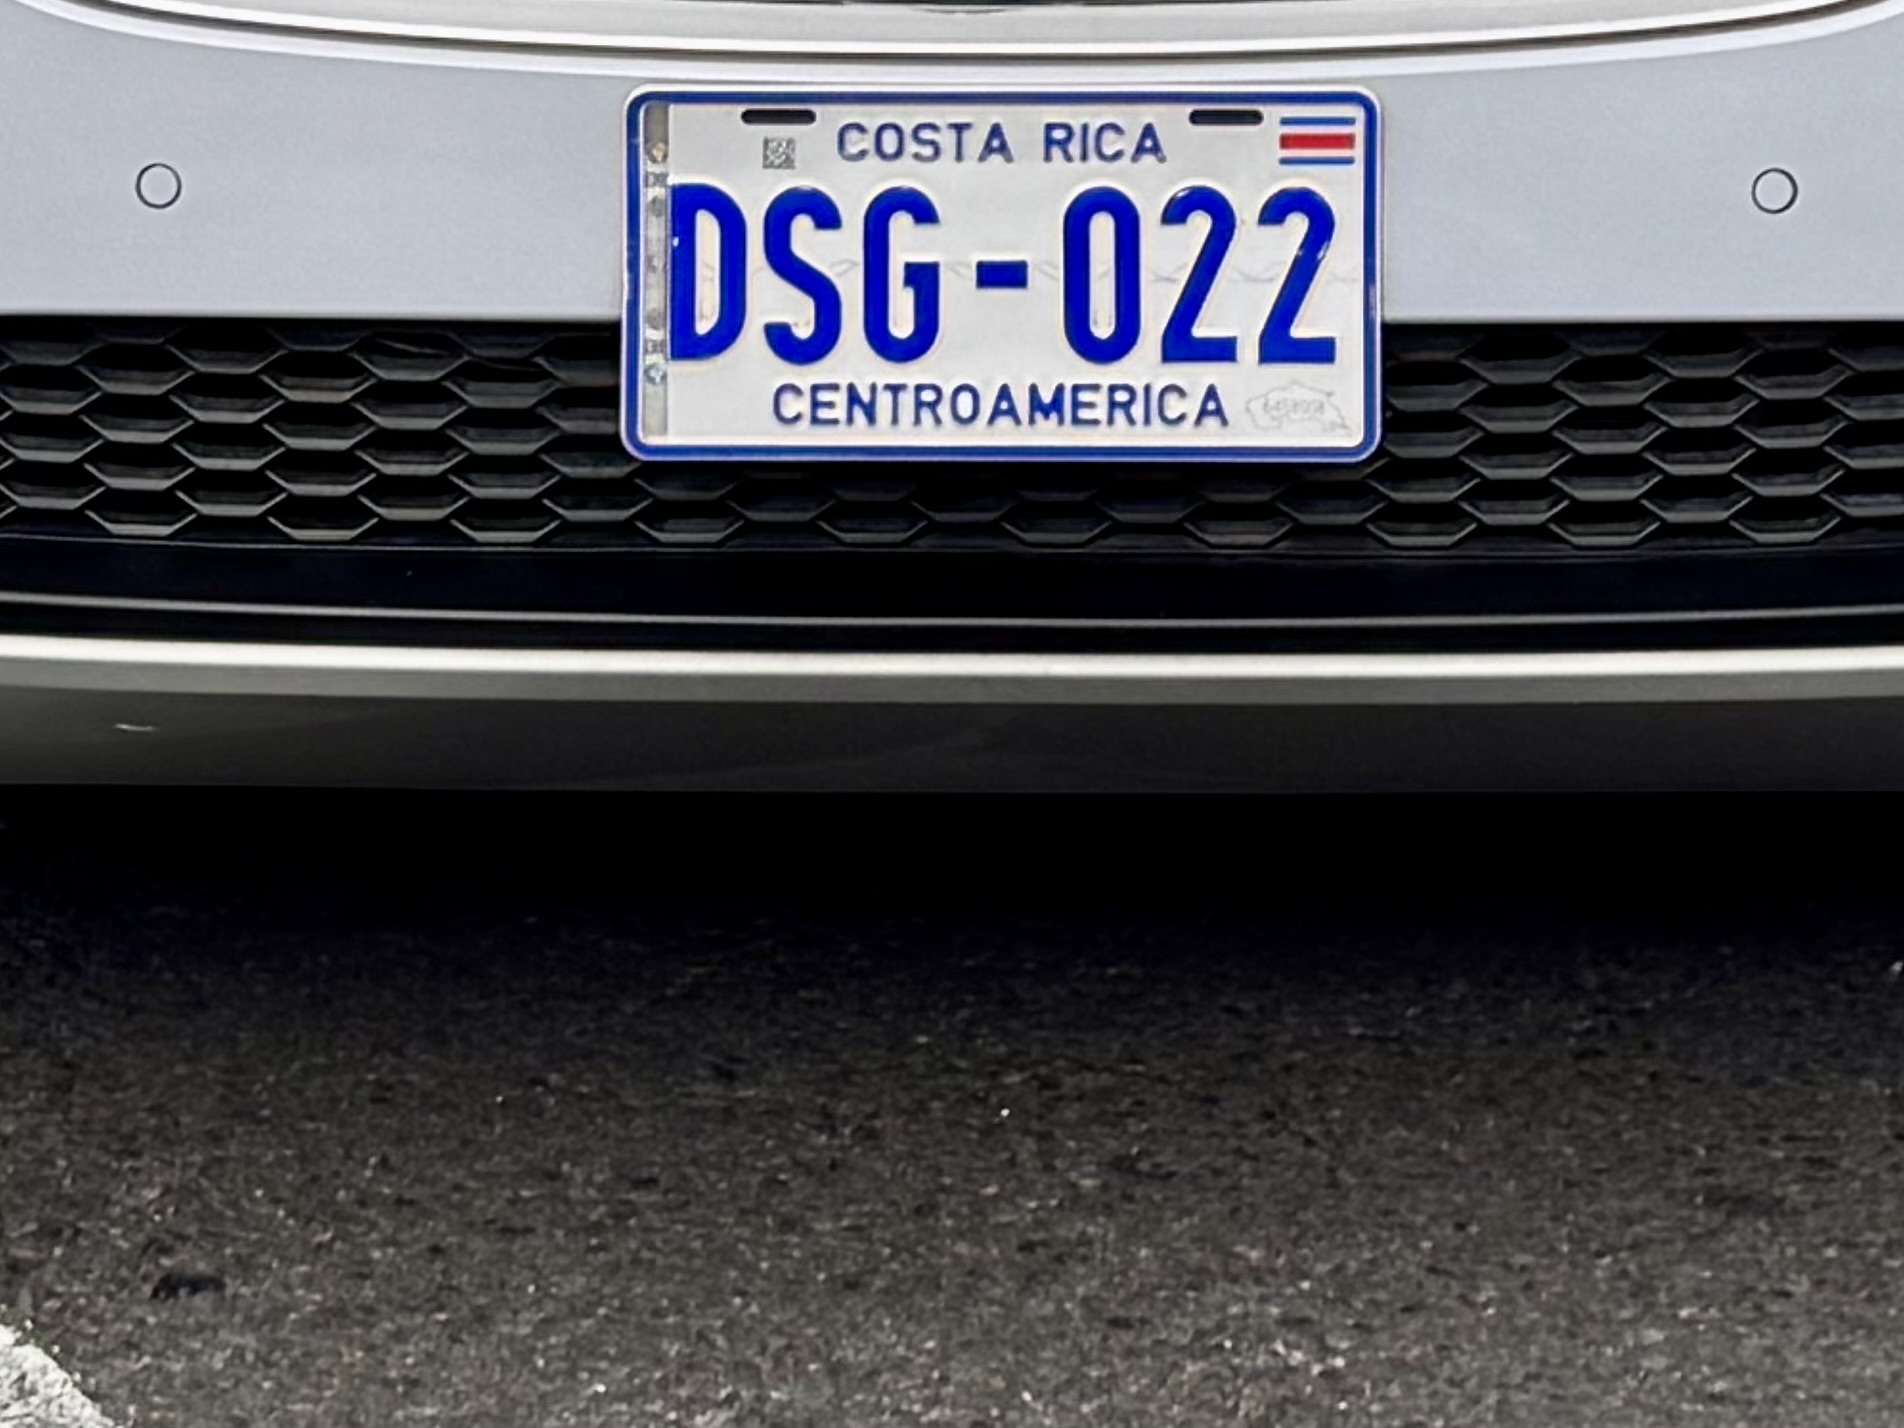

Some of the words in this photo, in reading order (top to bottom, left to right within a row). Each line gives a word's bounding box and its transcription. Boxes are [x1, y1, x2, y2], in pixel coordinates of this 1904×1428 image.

[836, 122, 1015, 163] COSTA
[1042, 122, 1167, 163] RICA
[669, 182, 1337, 365] DSG-022
[772, 382, 1230, 427] CENTROAMERICA
